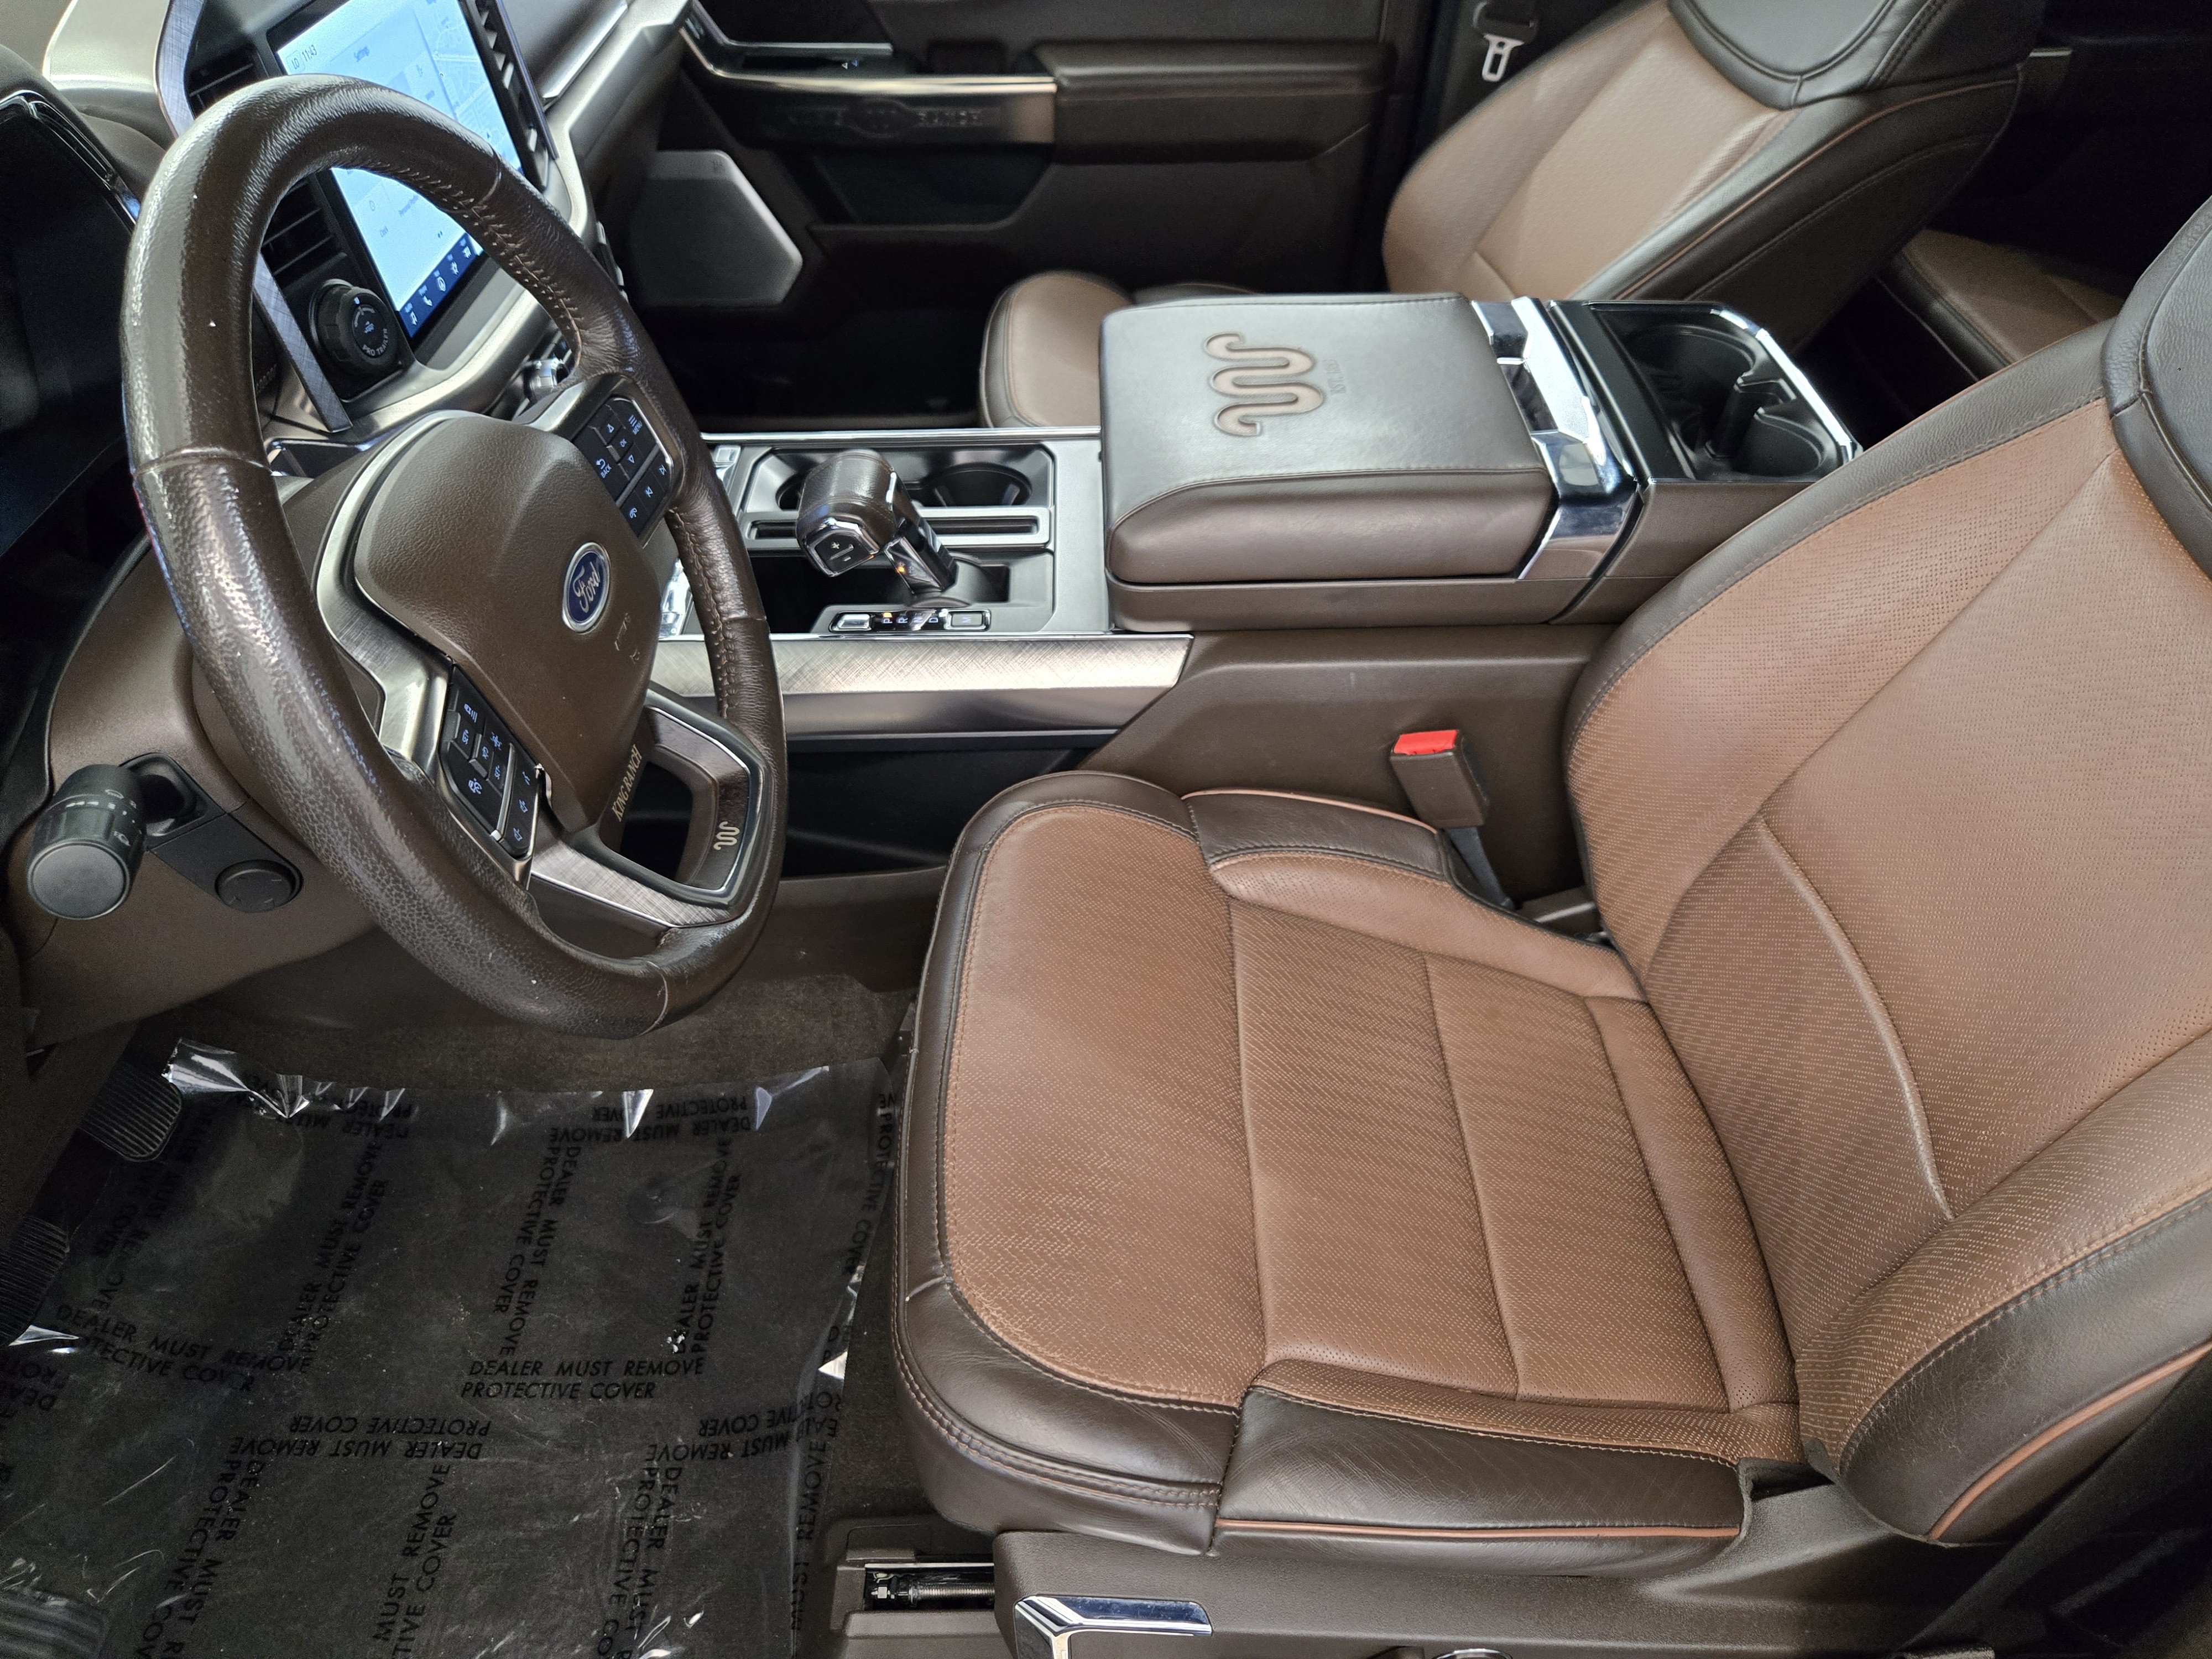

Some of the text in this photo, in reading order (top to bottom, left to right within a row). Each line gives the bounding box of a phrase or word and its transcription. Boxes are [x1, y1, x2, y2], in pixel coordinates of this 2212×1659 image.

[302, 44, 317, 62] 11:43
[600, 463, 612, 478] BACK
[620, 439, 627, 447] OK
[573, 561, 601, 613] Ford
[612, 744, 642, 822] KING RANCH
[353, 1179, 389, 1234] COVER
[493, 1146, 560, 1314] PROTECTIVE COVER
[500, 1145, 581, 1357] DEALER MUST REMOVE
[691, 1237, 726, 1353] PROTECTIVE
[56, 1303, 137, 1343] DEALER
[148, 1334, 213, 1361] MUST
[460, 1382, 657, 1400] PROTECTIVE COVER
[468, 1358, 706, 1377] DEALER MUST REMOVE
[229, 1439, 483, 1460] DEALER MUST REMOVE
[289, 1416, 492, 1437] PROTECTIVE COVER
[645, 1442, 732, 1462] REMOVE
[698, 1413, 759, 1437] COVER
[646, 1467, 682, 1550] DEALER
[796, 1441, 827, 1541] REMOVE
[164, 1459, 242, 1593] PROTECTIVE
[178, 1460, 263, 1626] DEALER MUST
[372, 1573, 410, 1642] MUST
[401, 1464, 451, 1557] REMOVE
[415, 1513, 458, 1593] COVER
[609, 1467, 660, 1605] PROTECTIVE
